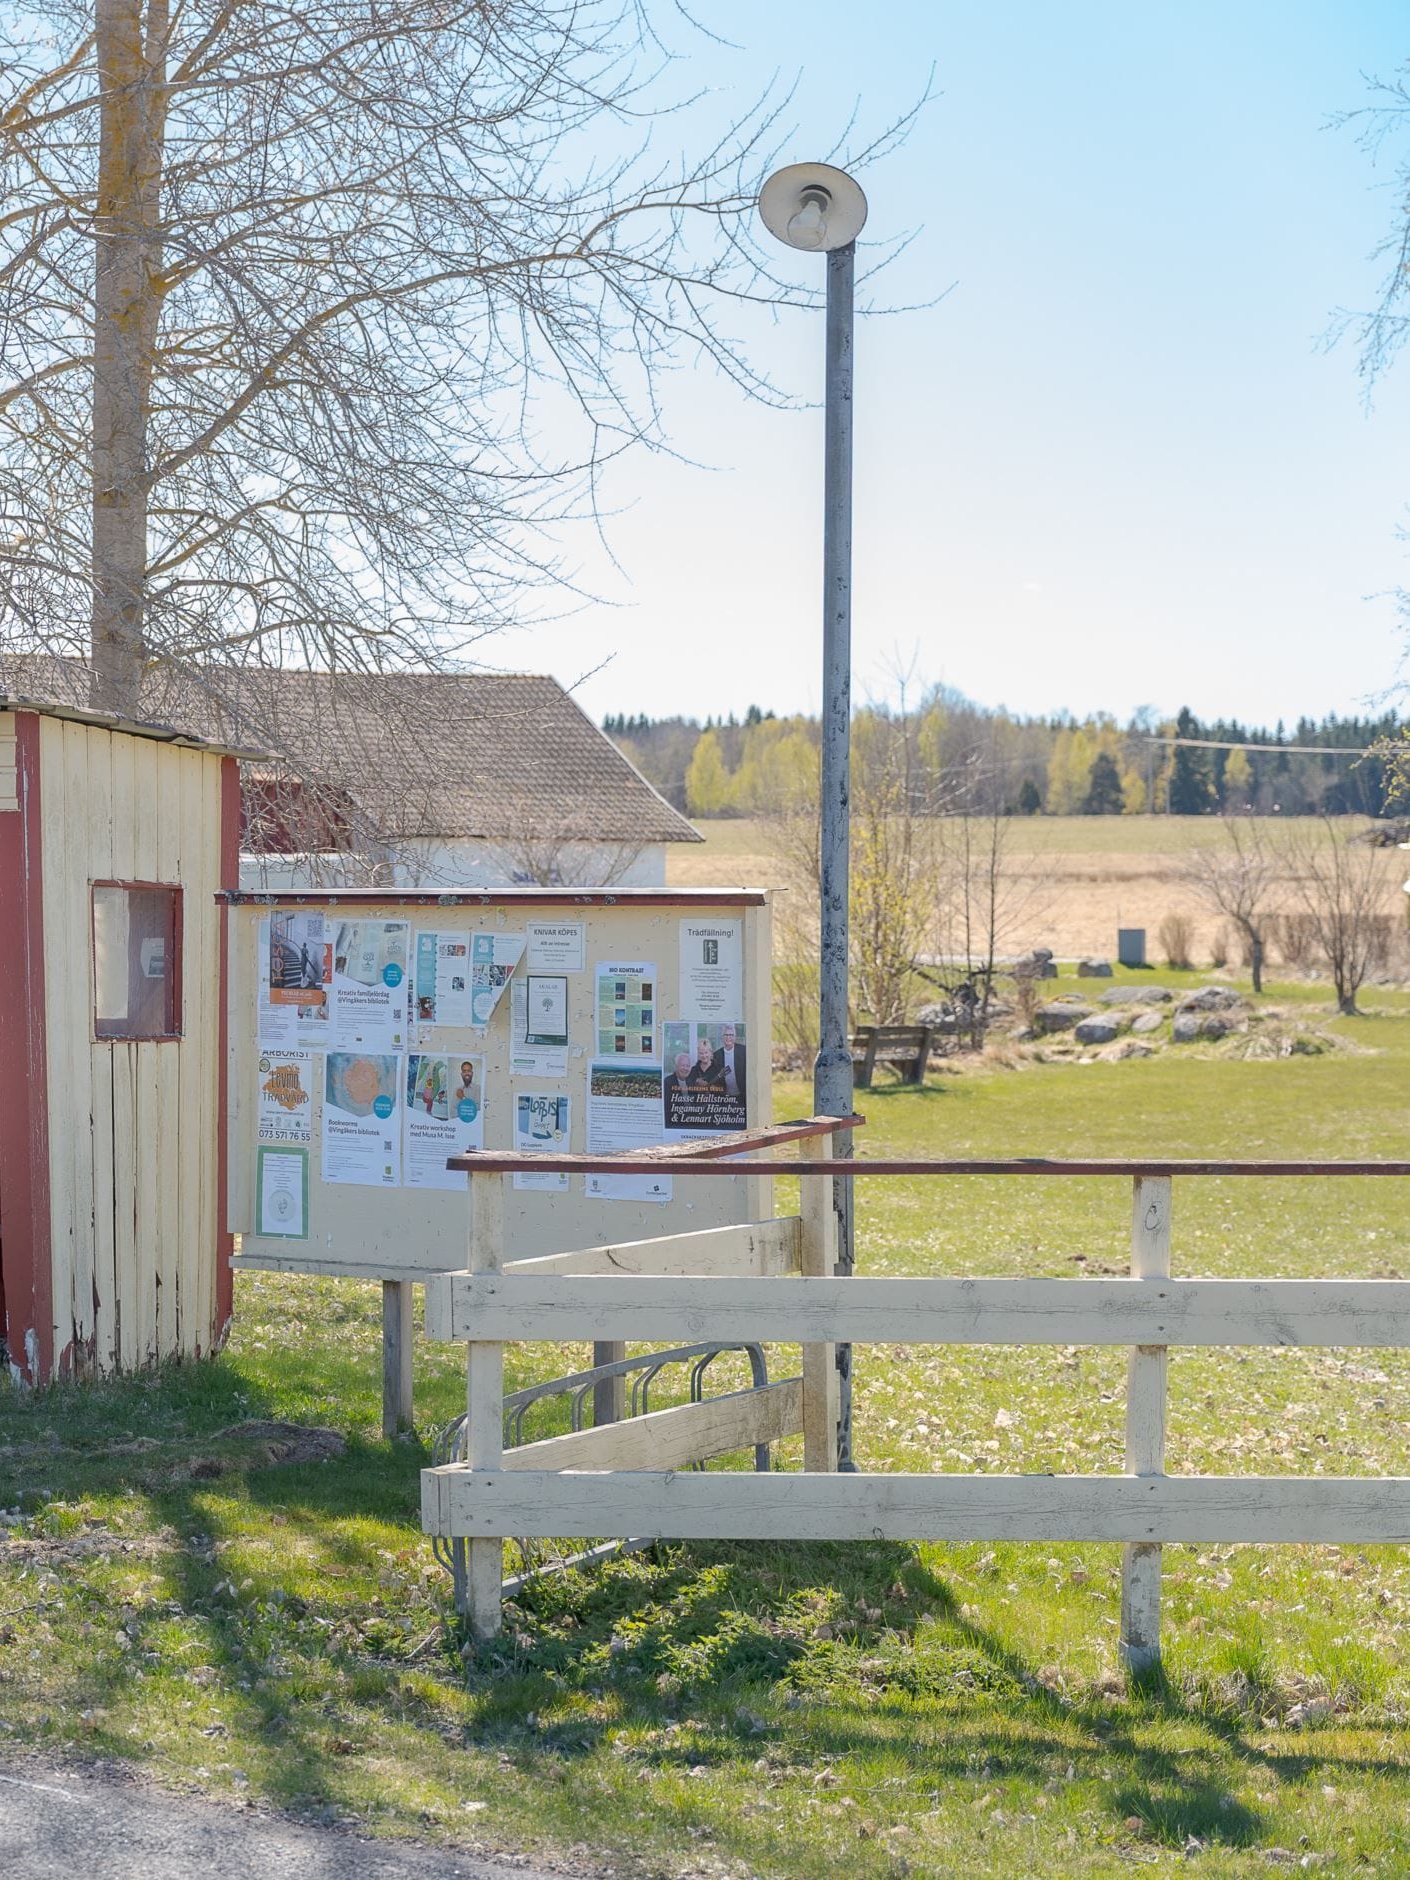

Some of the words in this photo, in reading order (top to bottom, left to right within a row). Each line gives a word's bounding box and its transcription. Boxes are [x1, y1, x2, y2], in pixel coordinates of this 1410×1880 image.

[558, 928, 578, 936] KÖPES
[687, 928, 734, 938] Trädfällning!
[357, 990, 390, 998] familjelördag
[671, 1093, 695, 1102] Hasse
[696, 1093, 738, 1104] Hallström,
[530, 1097, 557, 1122] LOPPIS
[671, 1104, 705, 1114] Ingamay
[706, 1104, 745, 1115] Hörnberg
[328, 1119, 358, 1127] Bookworms
[671, 1113, 679, 1123] &
[681, 1114, 711, 1123] Lennart
[712, 1114, 746, 1125] Sjöholm
[328, 1126, 358, 1134] @Vingåkers
[358, 1128, 381, 1136] bibliotek
[430, 1124, 456, 1132] workshop
[258, 1129, 274, 1139] 073
[275, 1130, 288, 1140] 571
[289, 1132, 299, 1140] 76
[301, 1133, 311, 1141] 55
